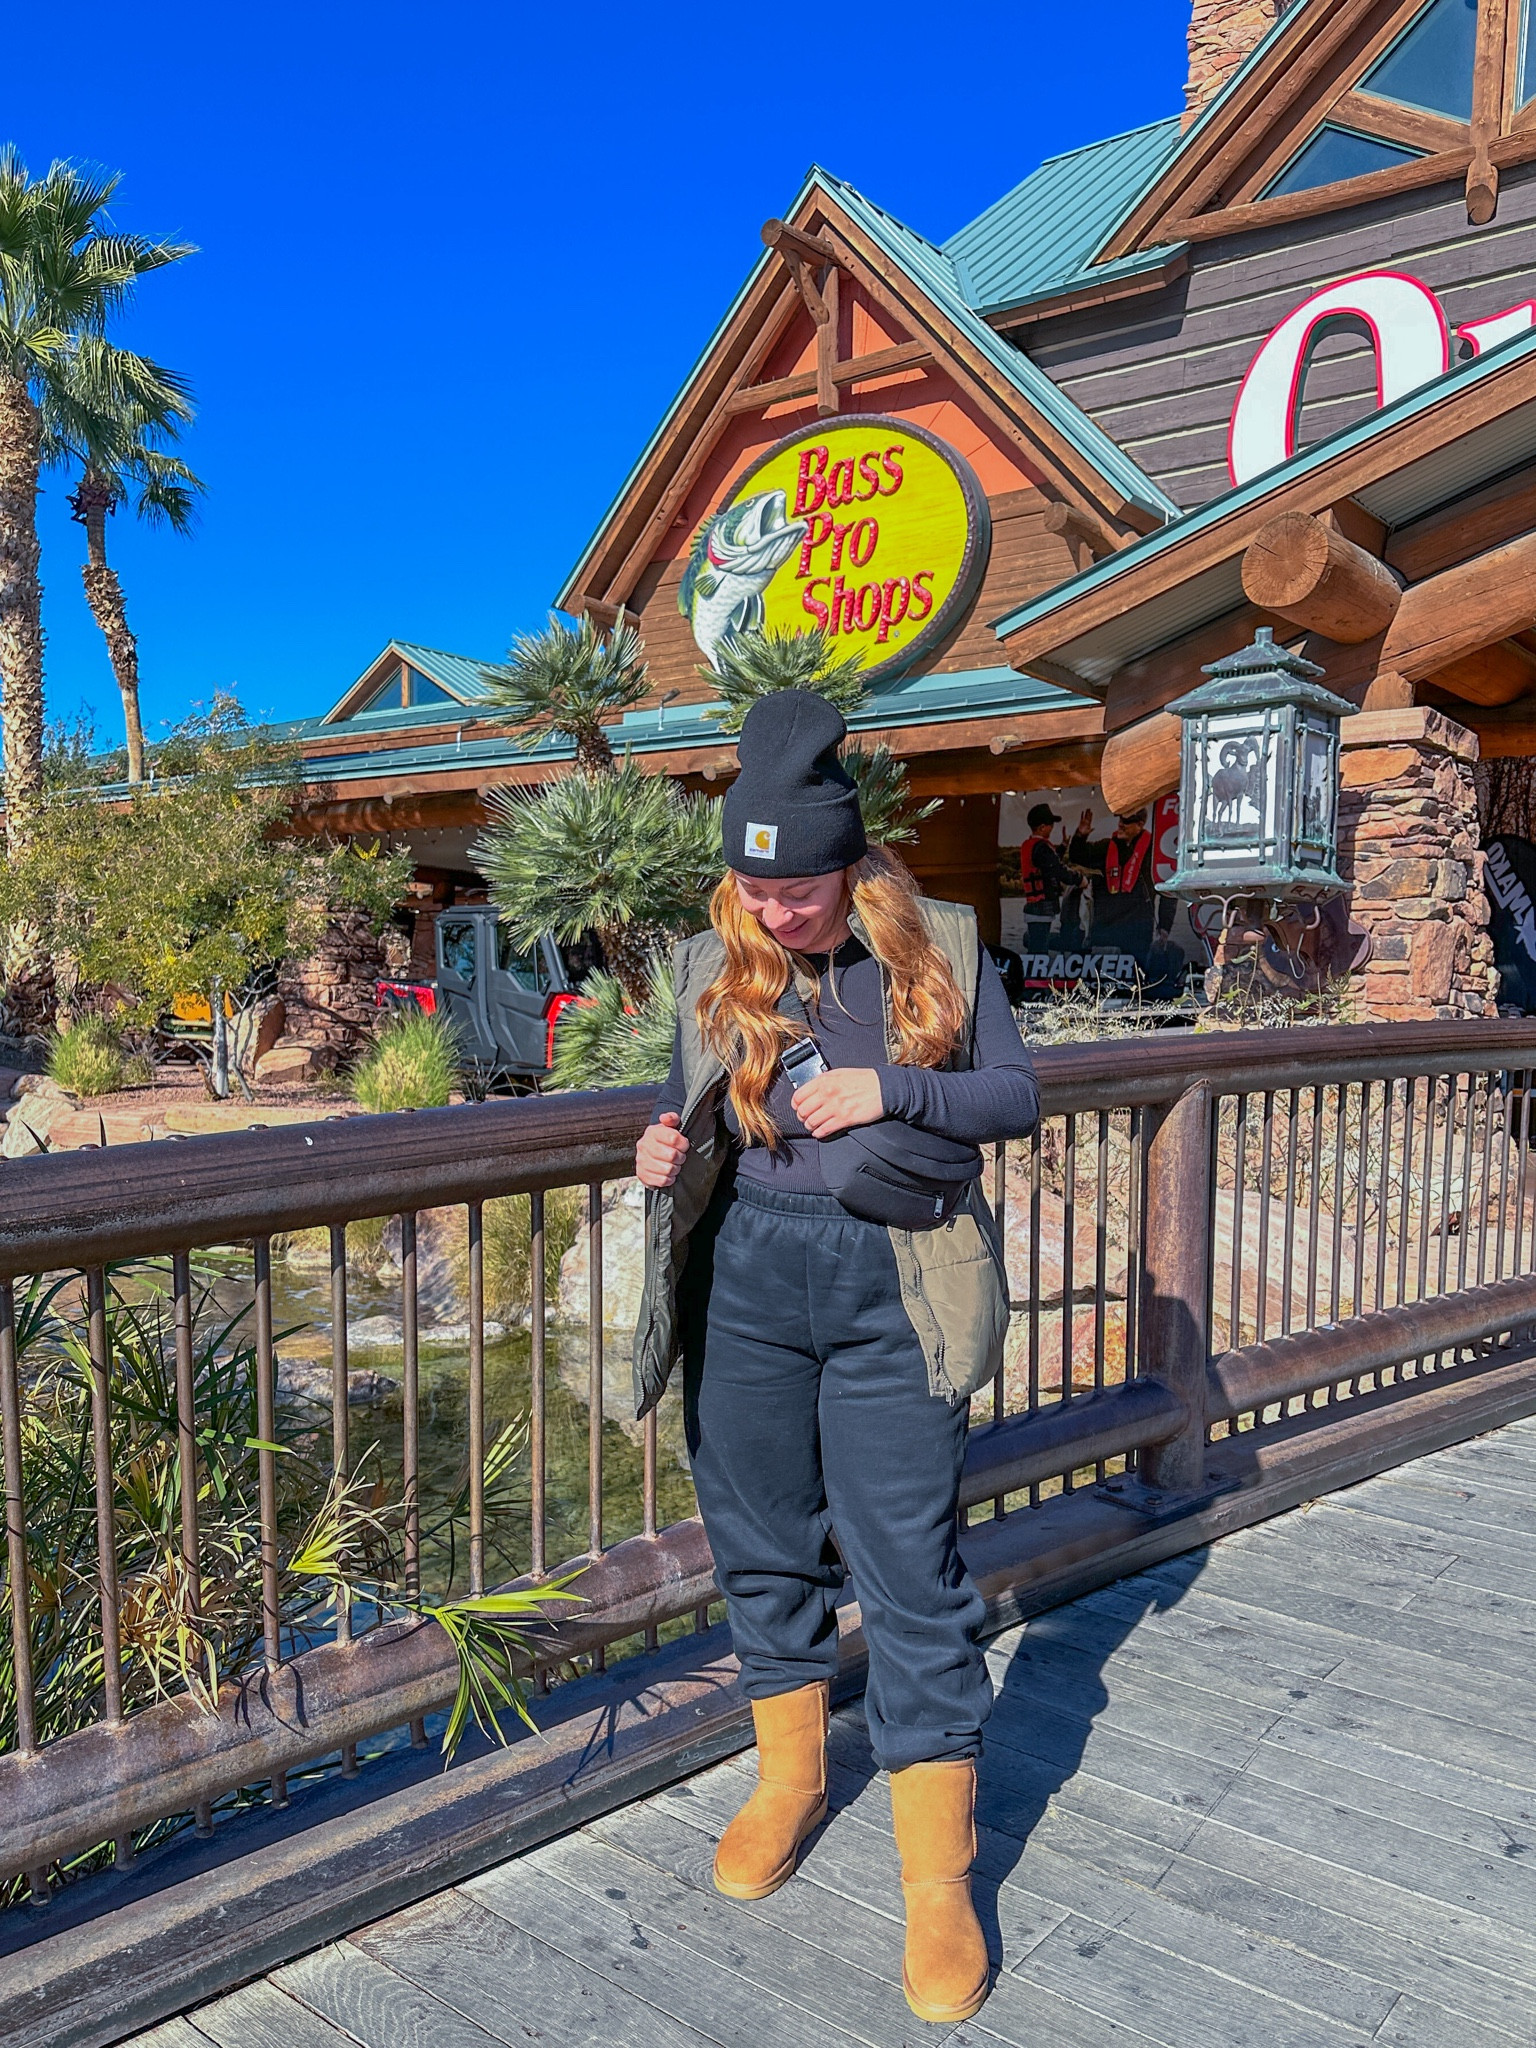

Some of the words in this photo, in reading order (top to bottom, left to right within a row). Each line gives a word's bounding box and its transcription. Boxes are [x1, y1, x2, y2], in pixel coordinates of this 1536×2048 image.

[791, 444, 905, 517] Bass
[795, 511, 879, 580] Pro
[796, 569, 935, 645] Shops
[1020, 953, 1136, 979] TRACKER
